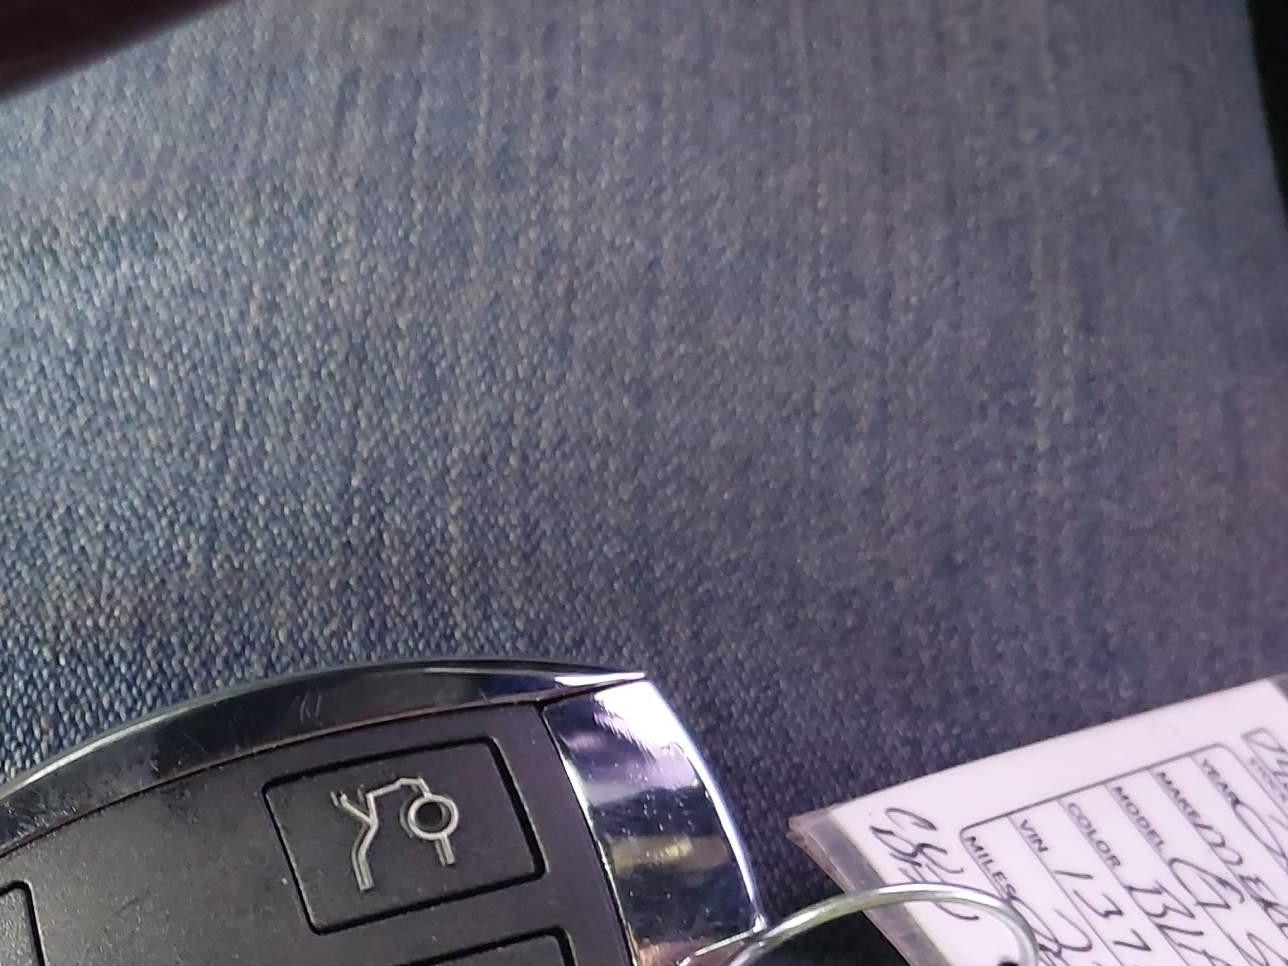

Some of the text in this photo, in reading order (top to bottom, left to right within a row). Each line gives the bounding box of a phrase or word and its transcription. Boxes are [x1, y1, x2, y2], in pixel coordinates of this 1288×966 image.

[1157, 771, 1201, 819] MAKE
[1202, 757, 1240, 806] YEAR
[1019, 818, 1049, 854] VIN
[1066, 801, 1123, 870] COLOR
[1112, 786, 1165, 849] MODEL
[964, 835, 1017, 898] MILES
